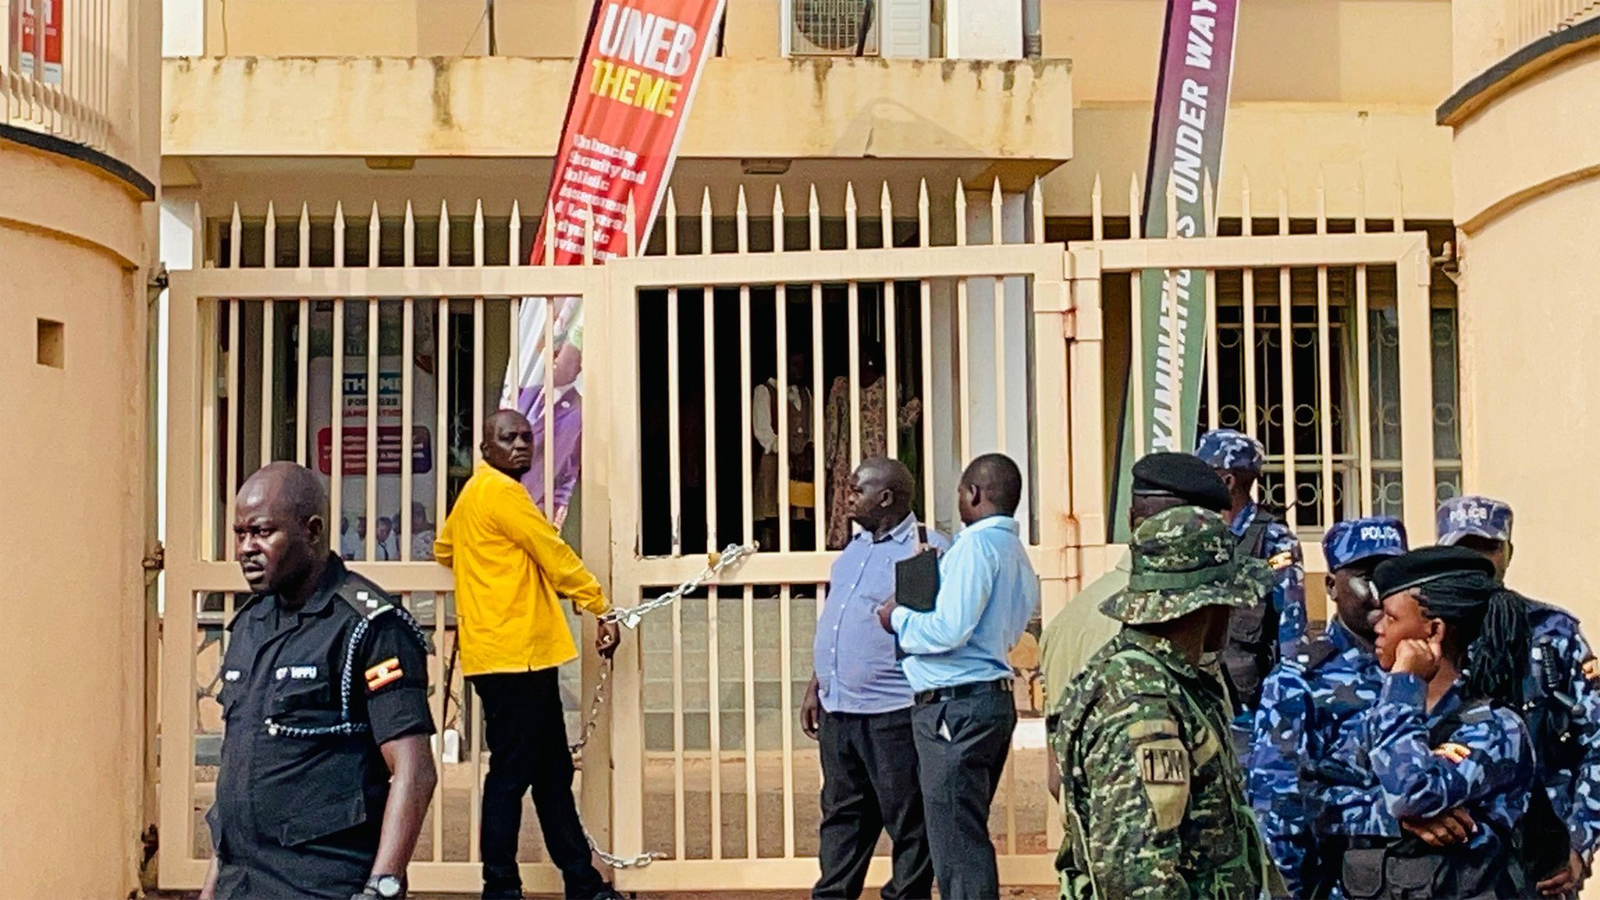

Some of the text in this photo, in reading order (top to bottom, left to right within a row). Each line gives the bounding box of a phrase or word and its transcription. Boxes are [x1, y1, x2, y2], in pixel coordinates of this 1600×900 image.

[598, 3, 697, 77] UNEB
[589, 57, 683, 118] THEME
[1171, 79, 1209, 203] UNDER
